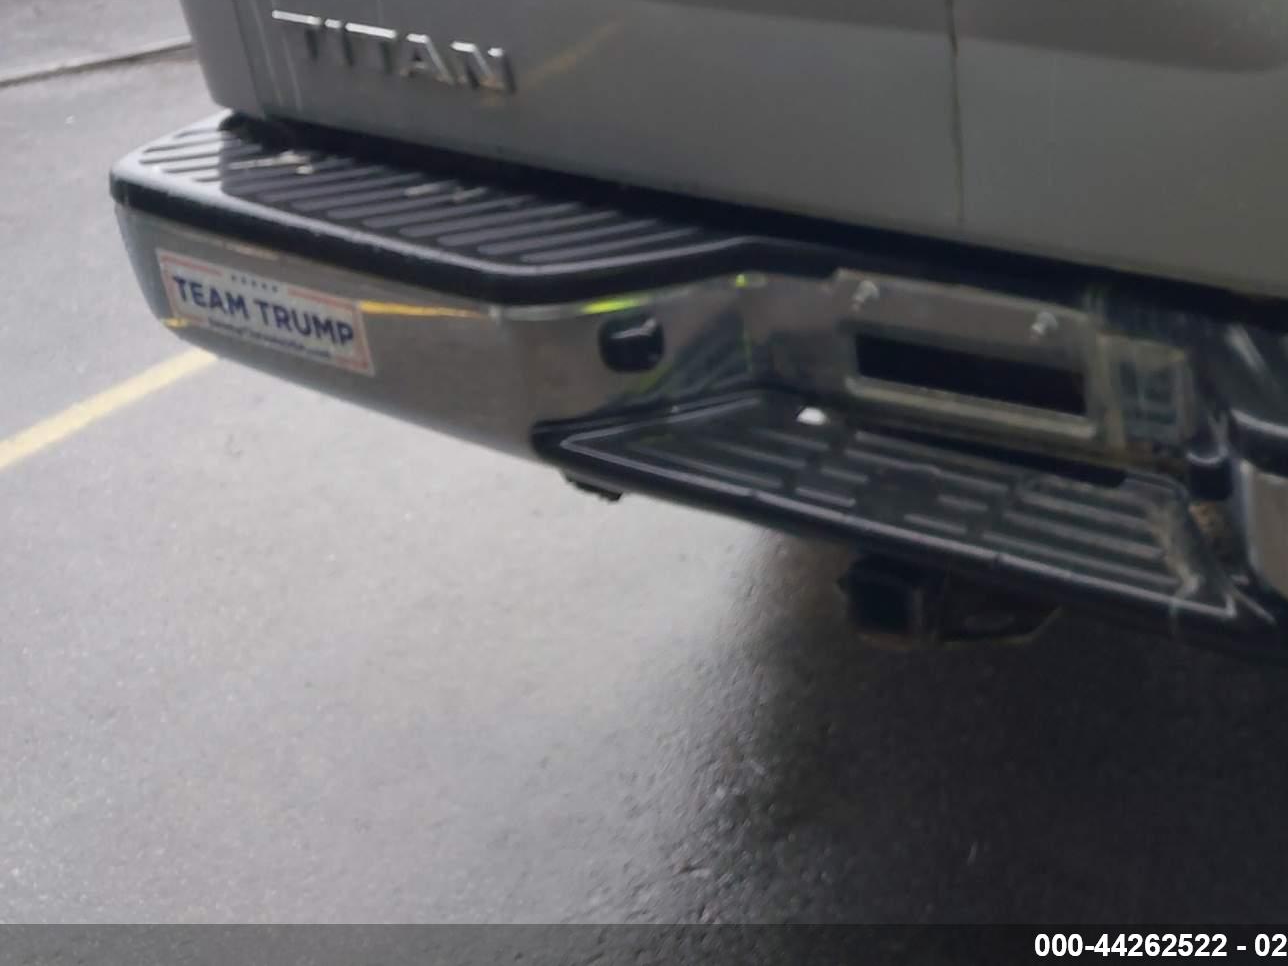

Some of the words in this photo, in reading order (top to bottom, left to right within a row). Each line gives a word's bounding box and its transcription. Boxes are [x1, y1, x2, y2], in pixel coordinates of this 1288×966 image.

[272, 10, 516, 92] TITAN
[172, 276, 249, 320] TEAM
[252, 300, 354, 347] TRUMP
